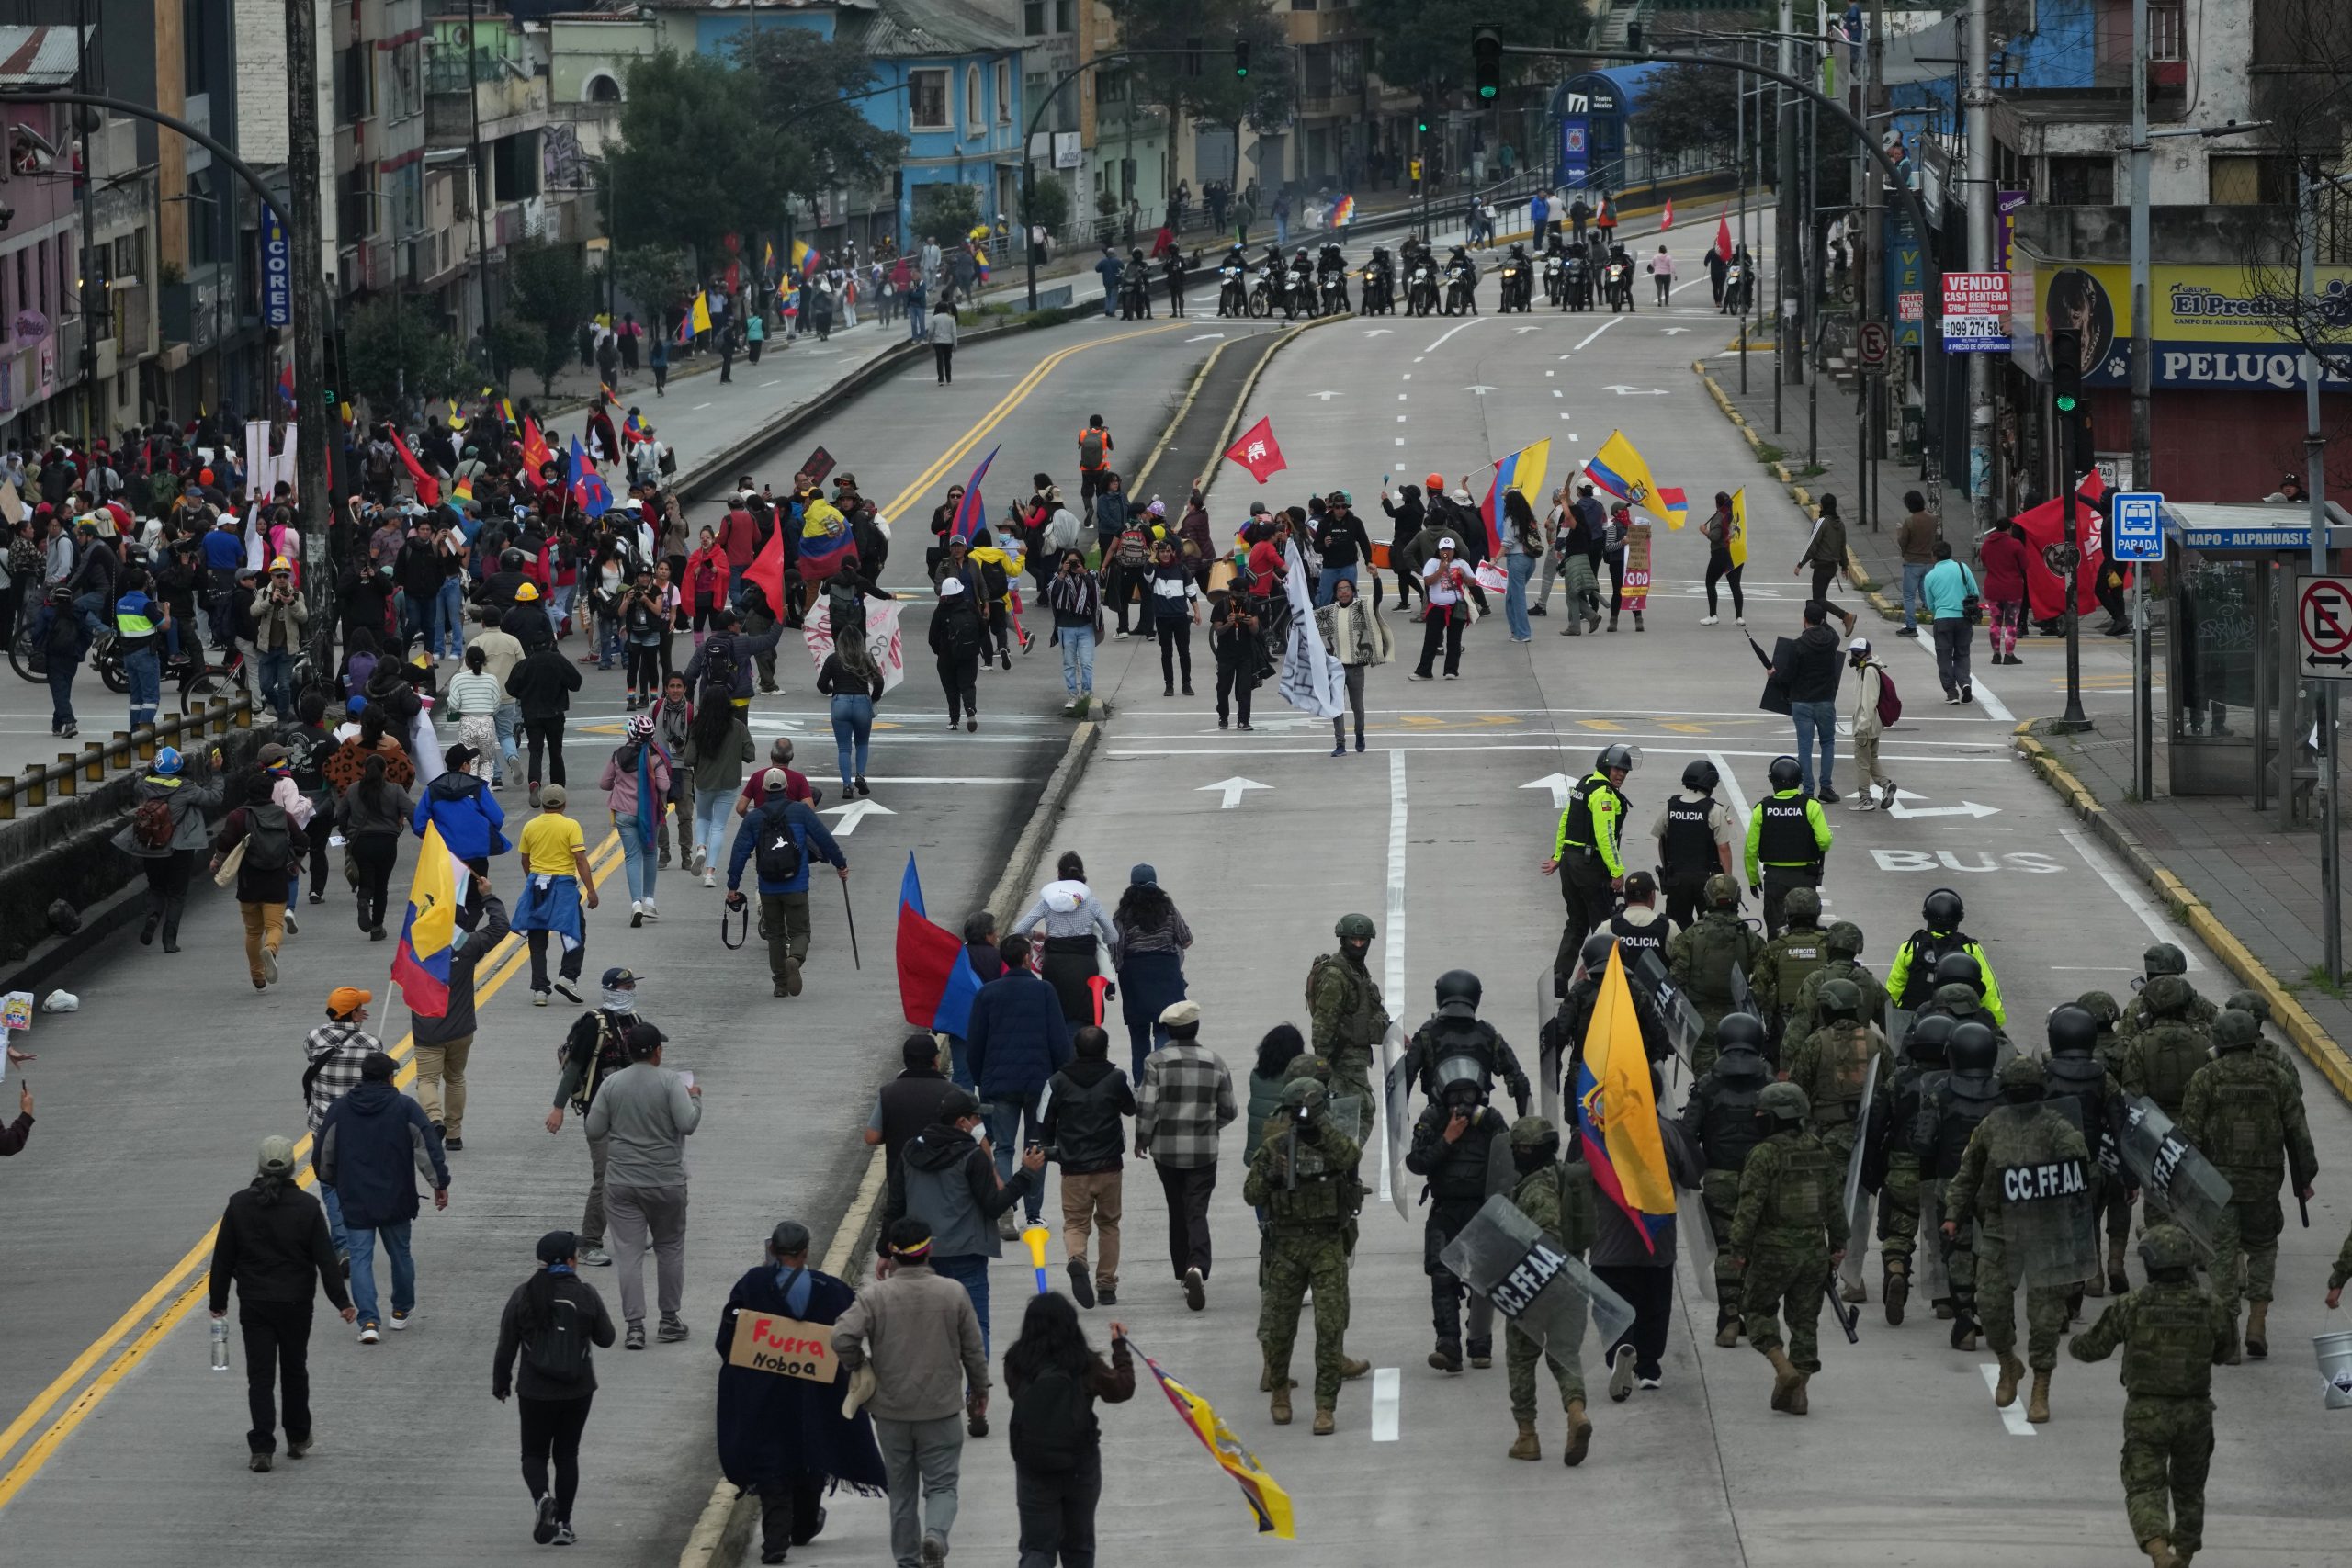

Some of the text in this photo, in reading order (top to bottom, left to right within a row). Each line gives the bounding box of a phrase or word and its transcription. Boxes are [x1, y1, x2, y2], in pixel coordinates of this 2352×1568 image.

[1948, 276, 2004, 290] VENDO
[1944, 292, 2008, 302] CASA RENTERA
[2173, 295, 2204, 315] El
[1950, 321, 1967, 336] 099
[1969, 321, 1984, 336] 271
[2118, 539, 2159, 551] PARADA
[2187, 534, 2222, 546] NAPO
[2232, 533, 2303, 545] ALPAHUASI
[1669, 810, 1704, 821] POLICIA
[1767, 807, 1803, 817] POLICIA
[1869, 849, 2068, 873] BUS
[1620, 935, 1660, 948] POLICIA
[2004, 1160, 2088, 1201] CC.FF.AA.
[1491, 1243, 1567, 1316] CC.FF.AA.
[752, 1319, 825, 1359] Fuera
[752, 1351, 817, 1376] Noboa
